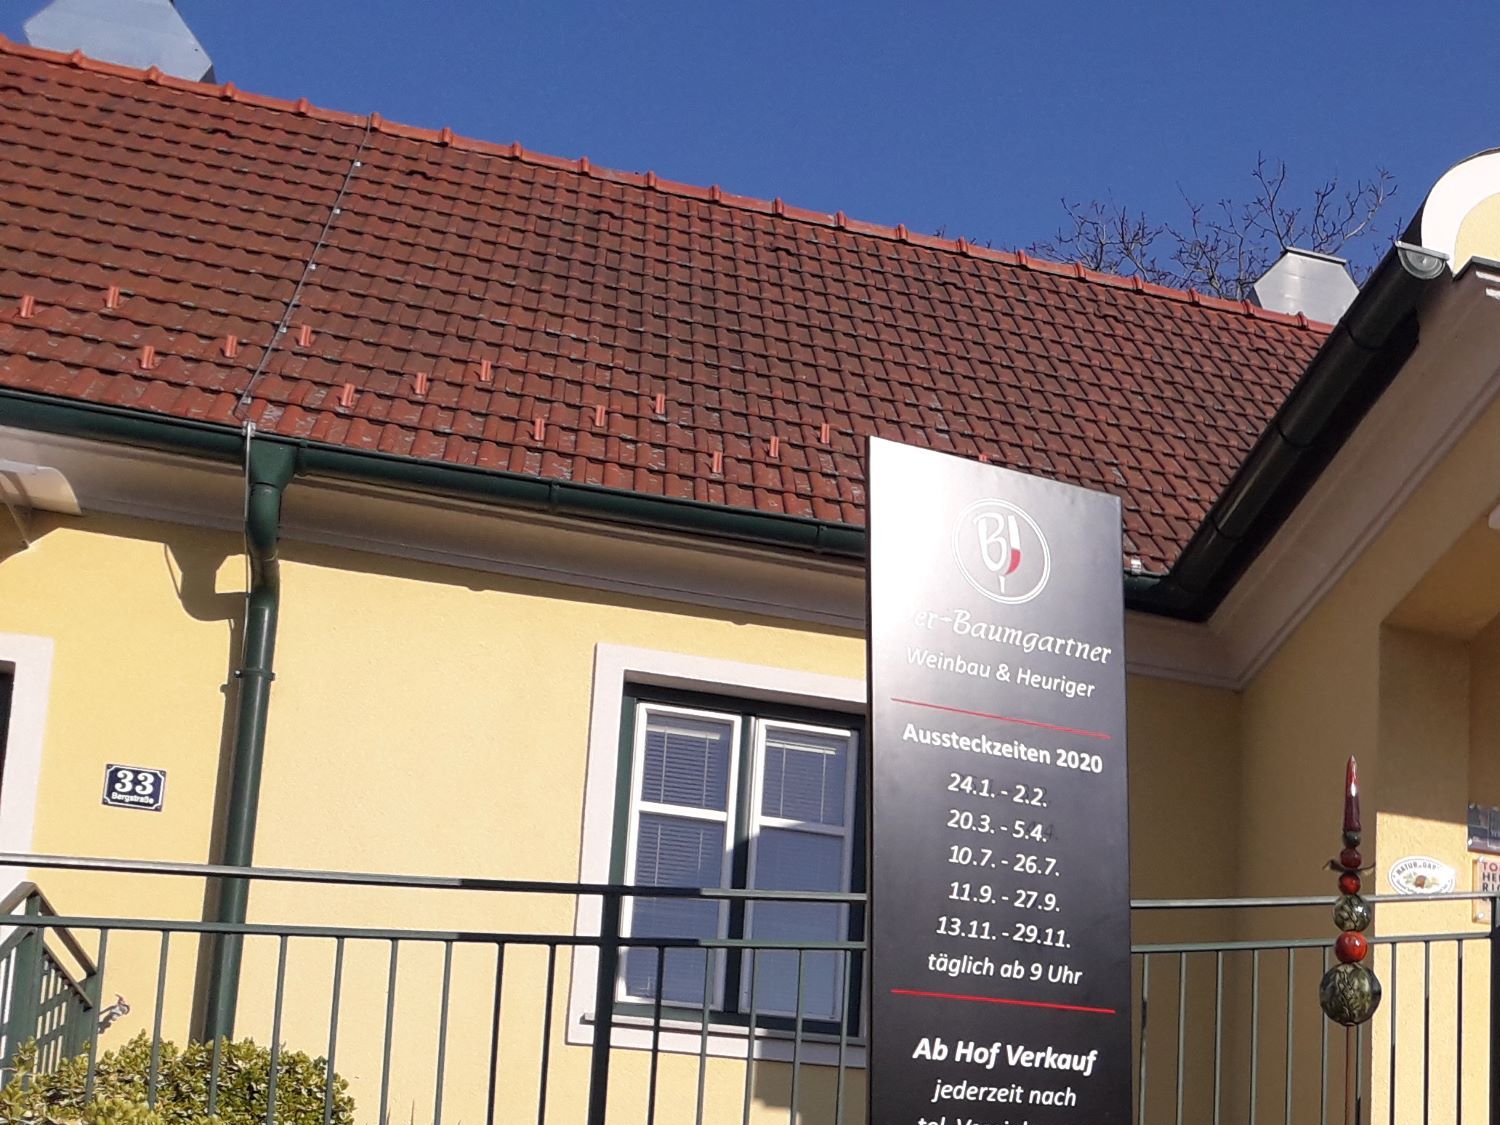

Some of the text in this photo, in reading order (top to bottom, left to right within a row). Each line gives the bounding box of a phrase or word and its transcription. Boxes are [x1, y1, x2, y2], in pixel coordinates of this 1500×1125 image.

[913, 608, 1112, 665] er-Baumgartner
[906, 647, 1096, 698] Weinbau & Heuriger
[902, 723, 1103, 774] Aussteckzeiten 2020
[114, 770, 155, 795] 33
[947, 773, 996, 799] 24.1.
[1013, 785, 1048, 808] 2.2.
[946, 809, 996, 836] 20.3.
[1012, 820, 1048, 844] 5.4.
[947, 844, 997, 869] 10.7.
[1013, 852, 1060, 877] 26.7.
[948, 881, 996, 905] 11.9.
[1013, 888, 1061, 913] 27.9.
[935, 916, 997, 941] 13.11.
[1012, 923, 1072, 949] 29.11.
[927, 953, 1083, 985] täglich ab 9 Uhr
[912, 1037, 1097, 1076] Ab Hof Verkauf
[931, 1080, 1077, 1107] jederzeit nach
